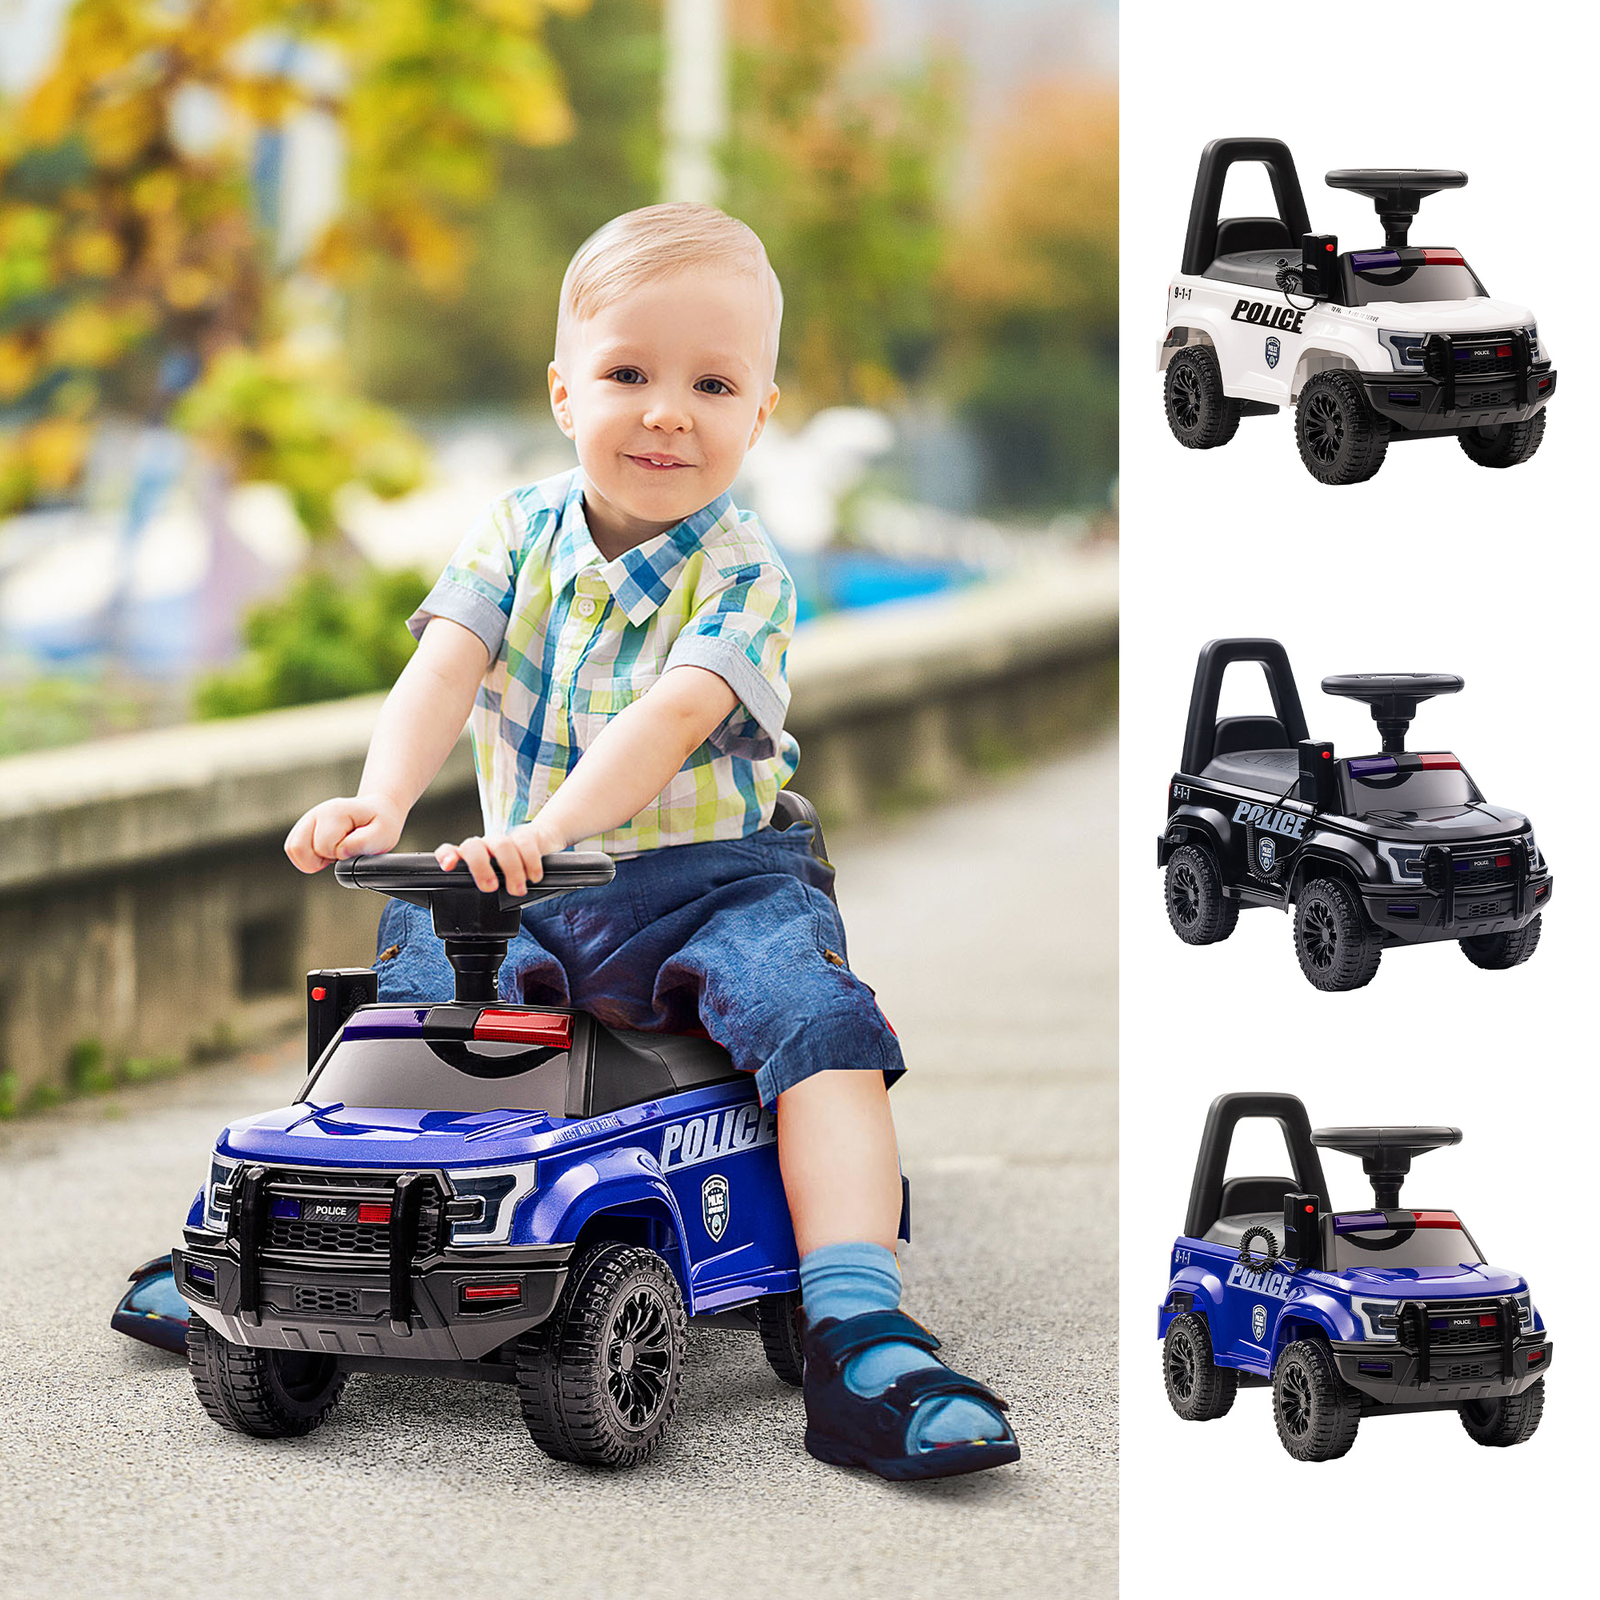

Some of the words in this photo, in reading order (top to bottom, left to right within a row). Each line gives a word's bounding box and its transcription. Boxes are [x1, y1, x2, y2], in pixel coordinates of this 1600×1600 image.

[1174, 287, 1192, 300] 9-1-1
[1231, 299, 1306, 334] POLICE
[1173, 785, 1191, 800] 9-1-1
[1232, 801, 1307, 840] POLICE
[660, 1104, 778, 1174] POLICE
[315, 1205, 347, 1216] POLICE
[1174, 1249, 1191, 1265] 9-1-1
[1226, 1263, 1292, 1301] POLICE
